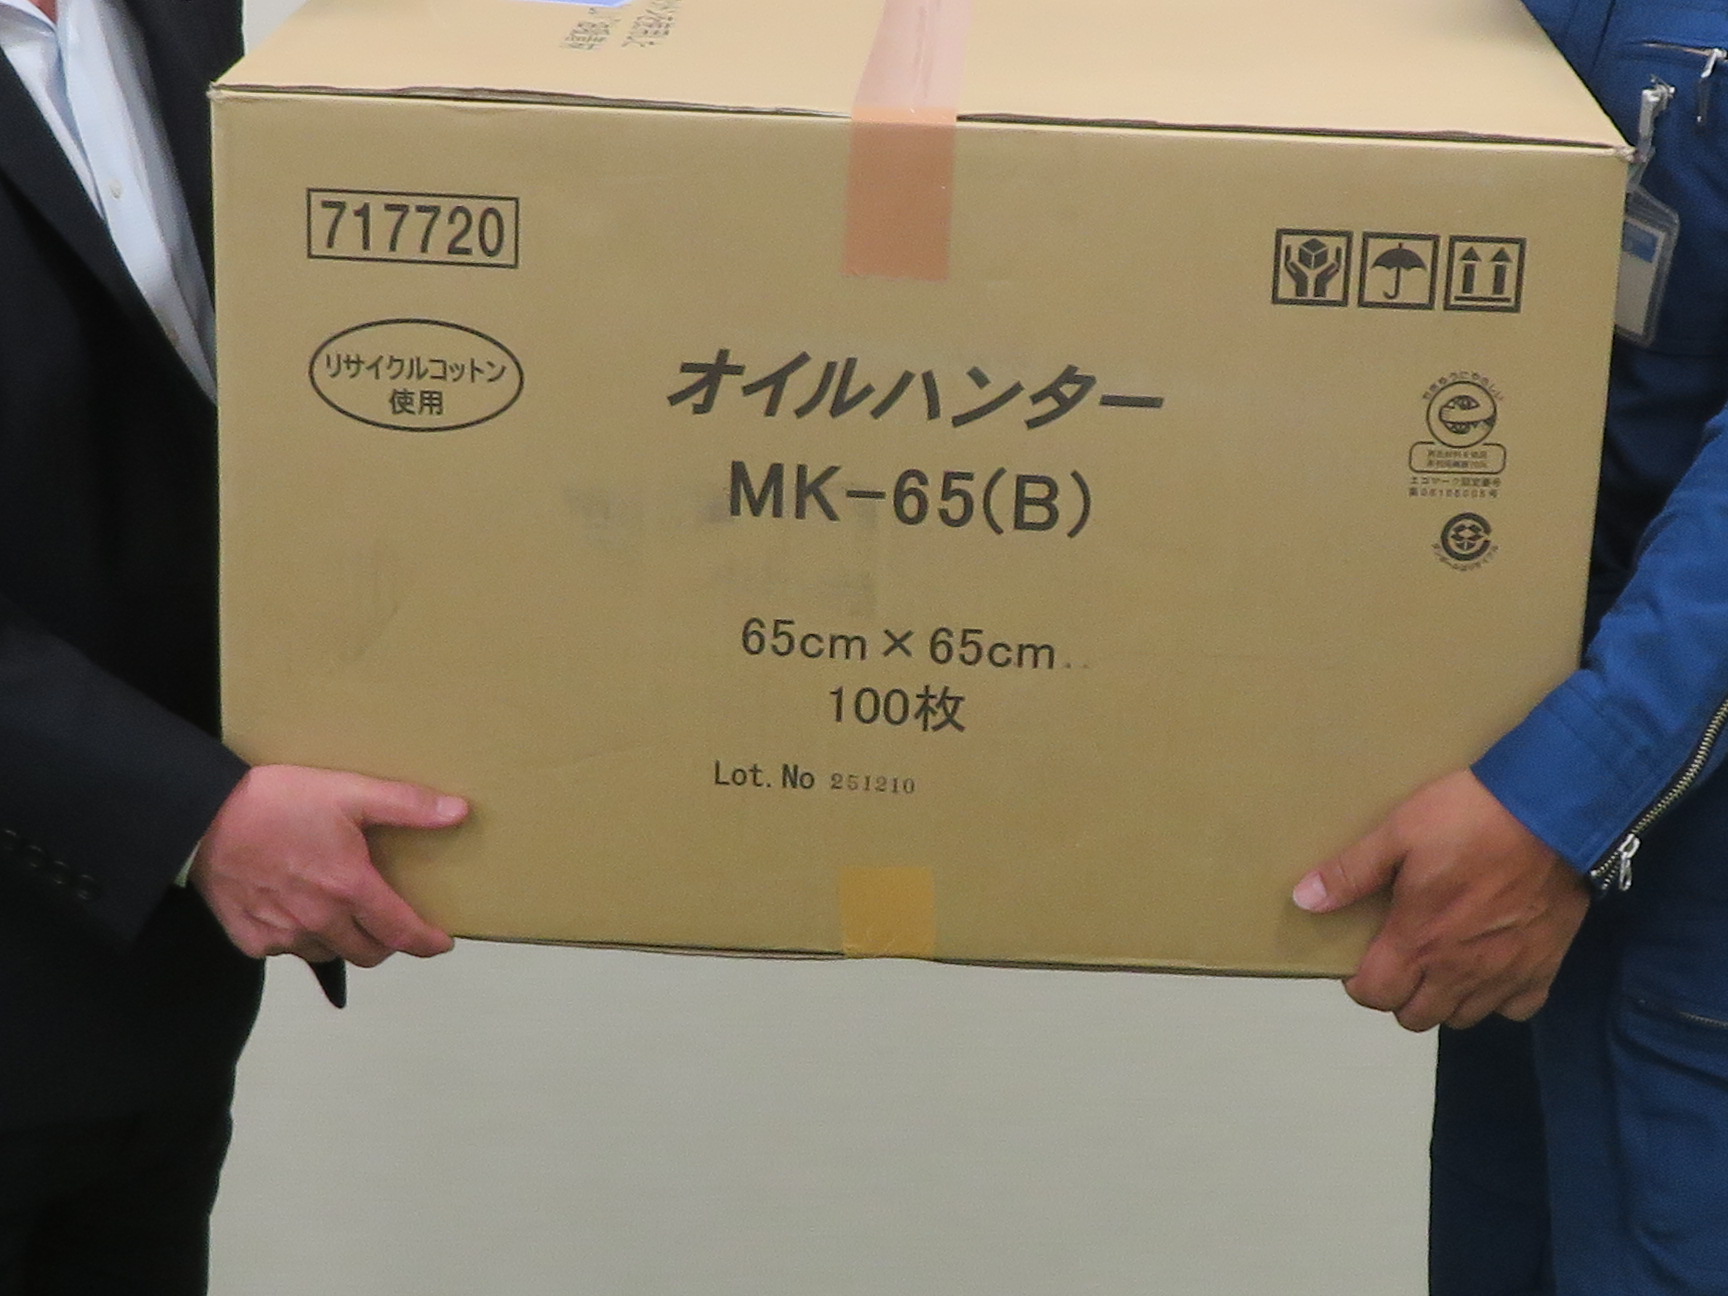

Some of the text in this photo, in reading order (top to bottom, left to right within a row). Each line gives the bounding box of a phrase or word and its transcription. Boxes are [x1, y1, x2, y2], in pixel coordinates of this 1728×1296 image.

[319, 199, 507, 259] 717720
[324, 351, 508, 385] リサイクルコットン
[388, 388, 445, 416] 使用
[666, 348, 1165, 431] オイルハンター
[829, 684, 966, 733] 100枚
[781, 763, 816, 790] No
[830, 771, 917, 795] 251210
